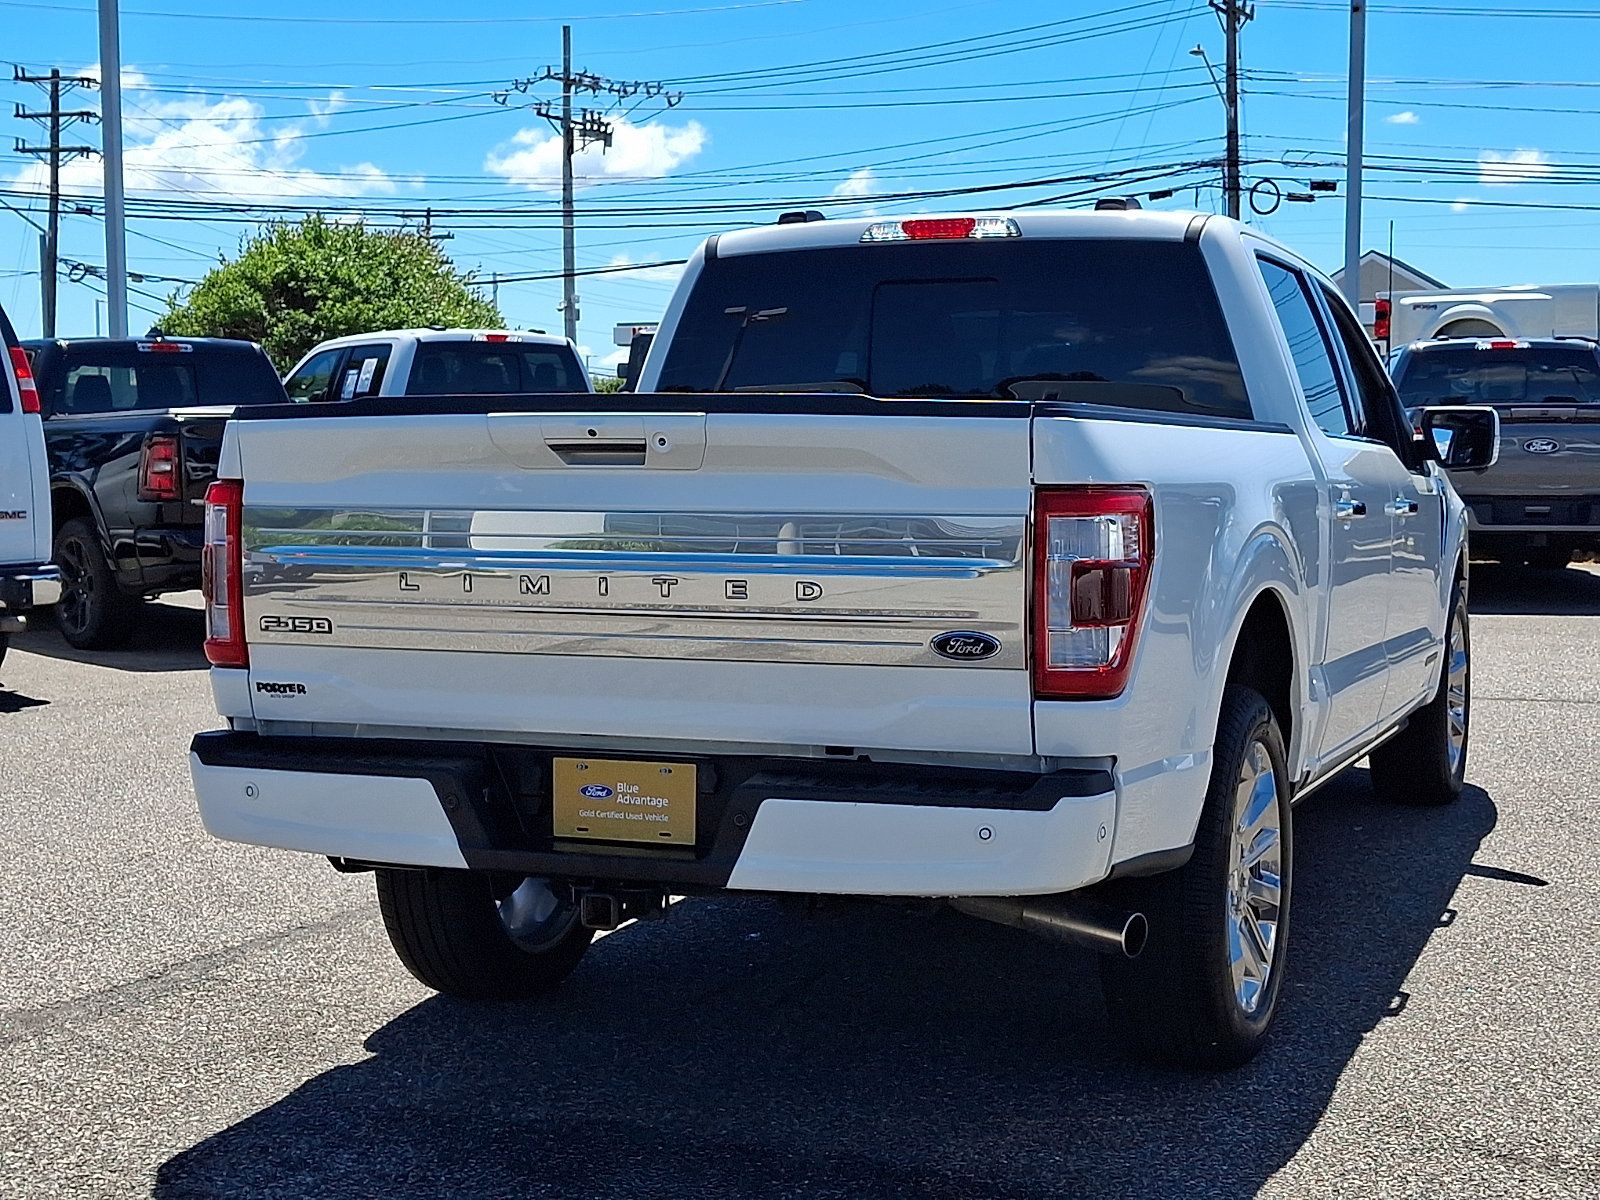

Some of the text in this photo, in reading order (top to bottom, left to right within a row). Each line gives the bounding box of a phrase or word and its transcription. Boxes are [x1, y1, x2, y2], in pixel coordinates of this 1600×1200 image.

[399, 572, 823, 601] LIMITED
[260, 615, 333, 635] F-150
[946, 637, 984, 654] Ford
[255, 681, 307, 695] PORTER
[585, 786, 608, 797] Ford
[617, 782, 639, 793] Blue
[616, 794, 669, 807] Advantage
[579, 809, 669, 822] Gold Certified Used Vehicle
